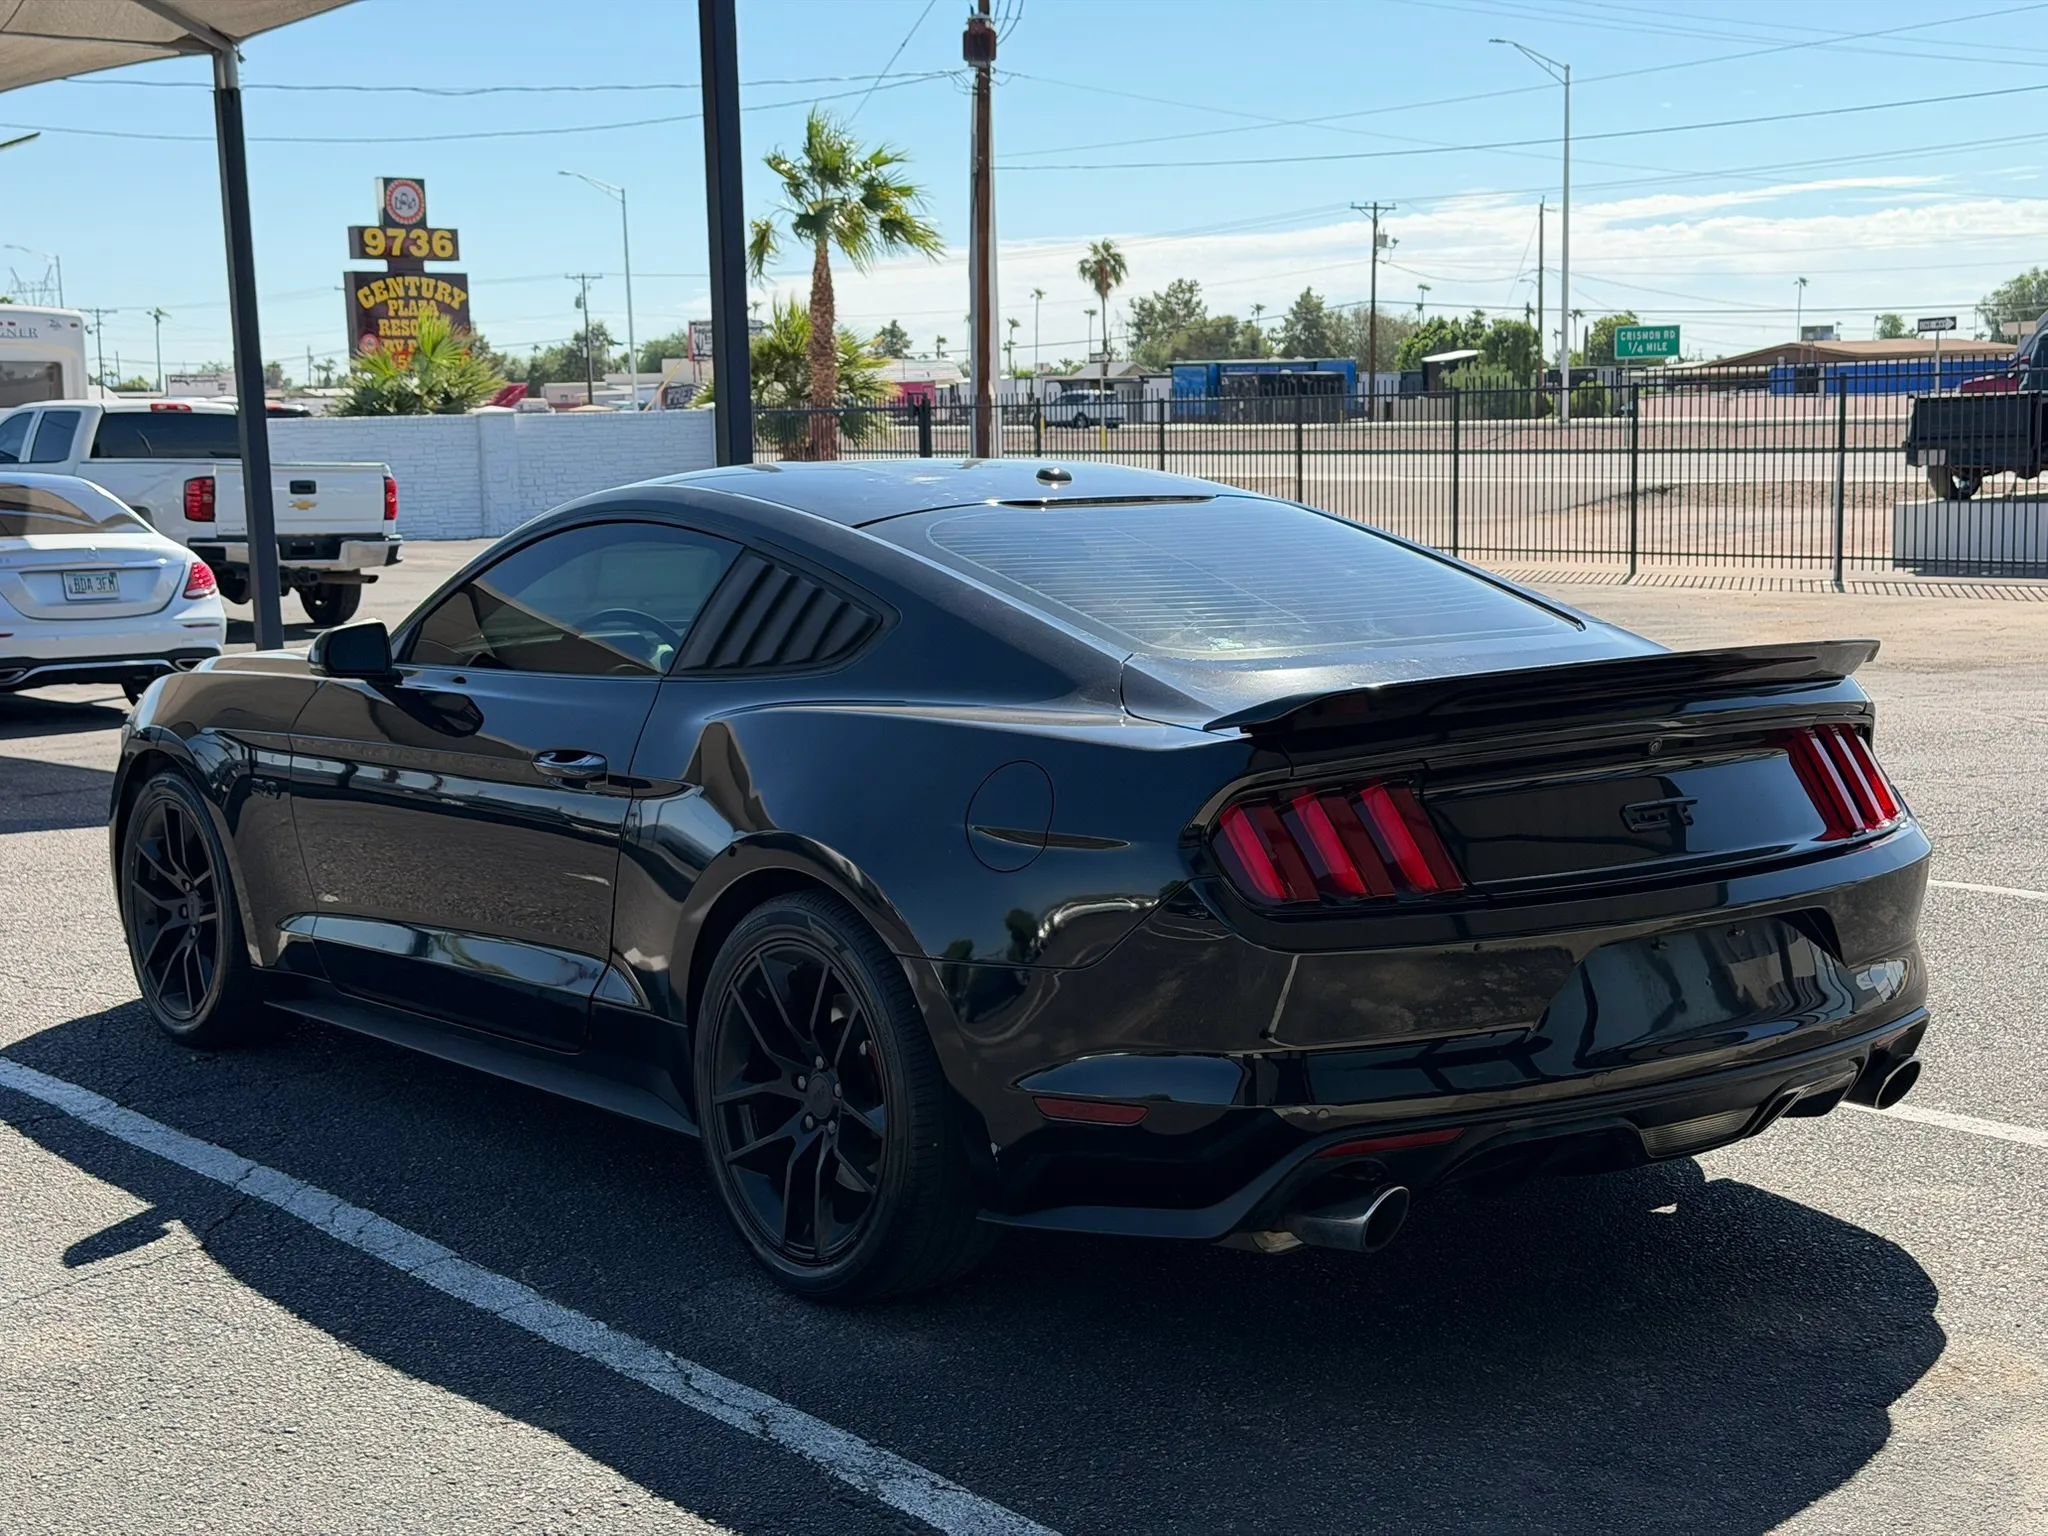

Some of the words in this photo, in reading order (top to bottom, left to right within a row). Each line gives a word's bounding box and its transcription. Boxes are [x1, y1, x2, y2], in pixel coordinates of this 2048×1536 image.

[363, 227, 454, 258] 9736
[357, 276, 467, 310] CENTURY
[378, 319, 440, 336] RESO
[1620, 330, 1661, 341] CRISMON
[1663, 329, 1676, 340] RD
[1628, 341, 1644, 355] 1/4
[1646, 341, 1668, 353] MILE
[1619, 796, 1699, 834] GT
